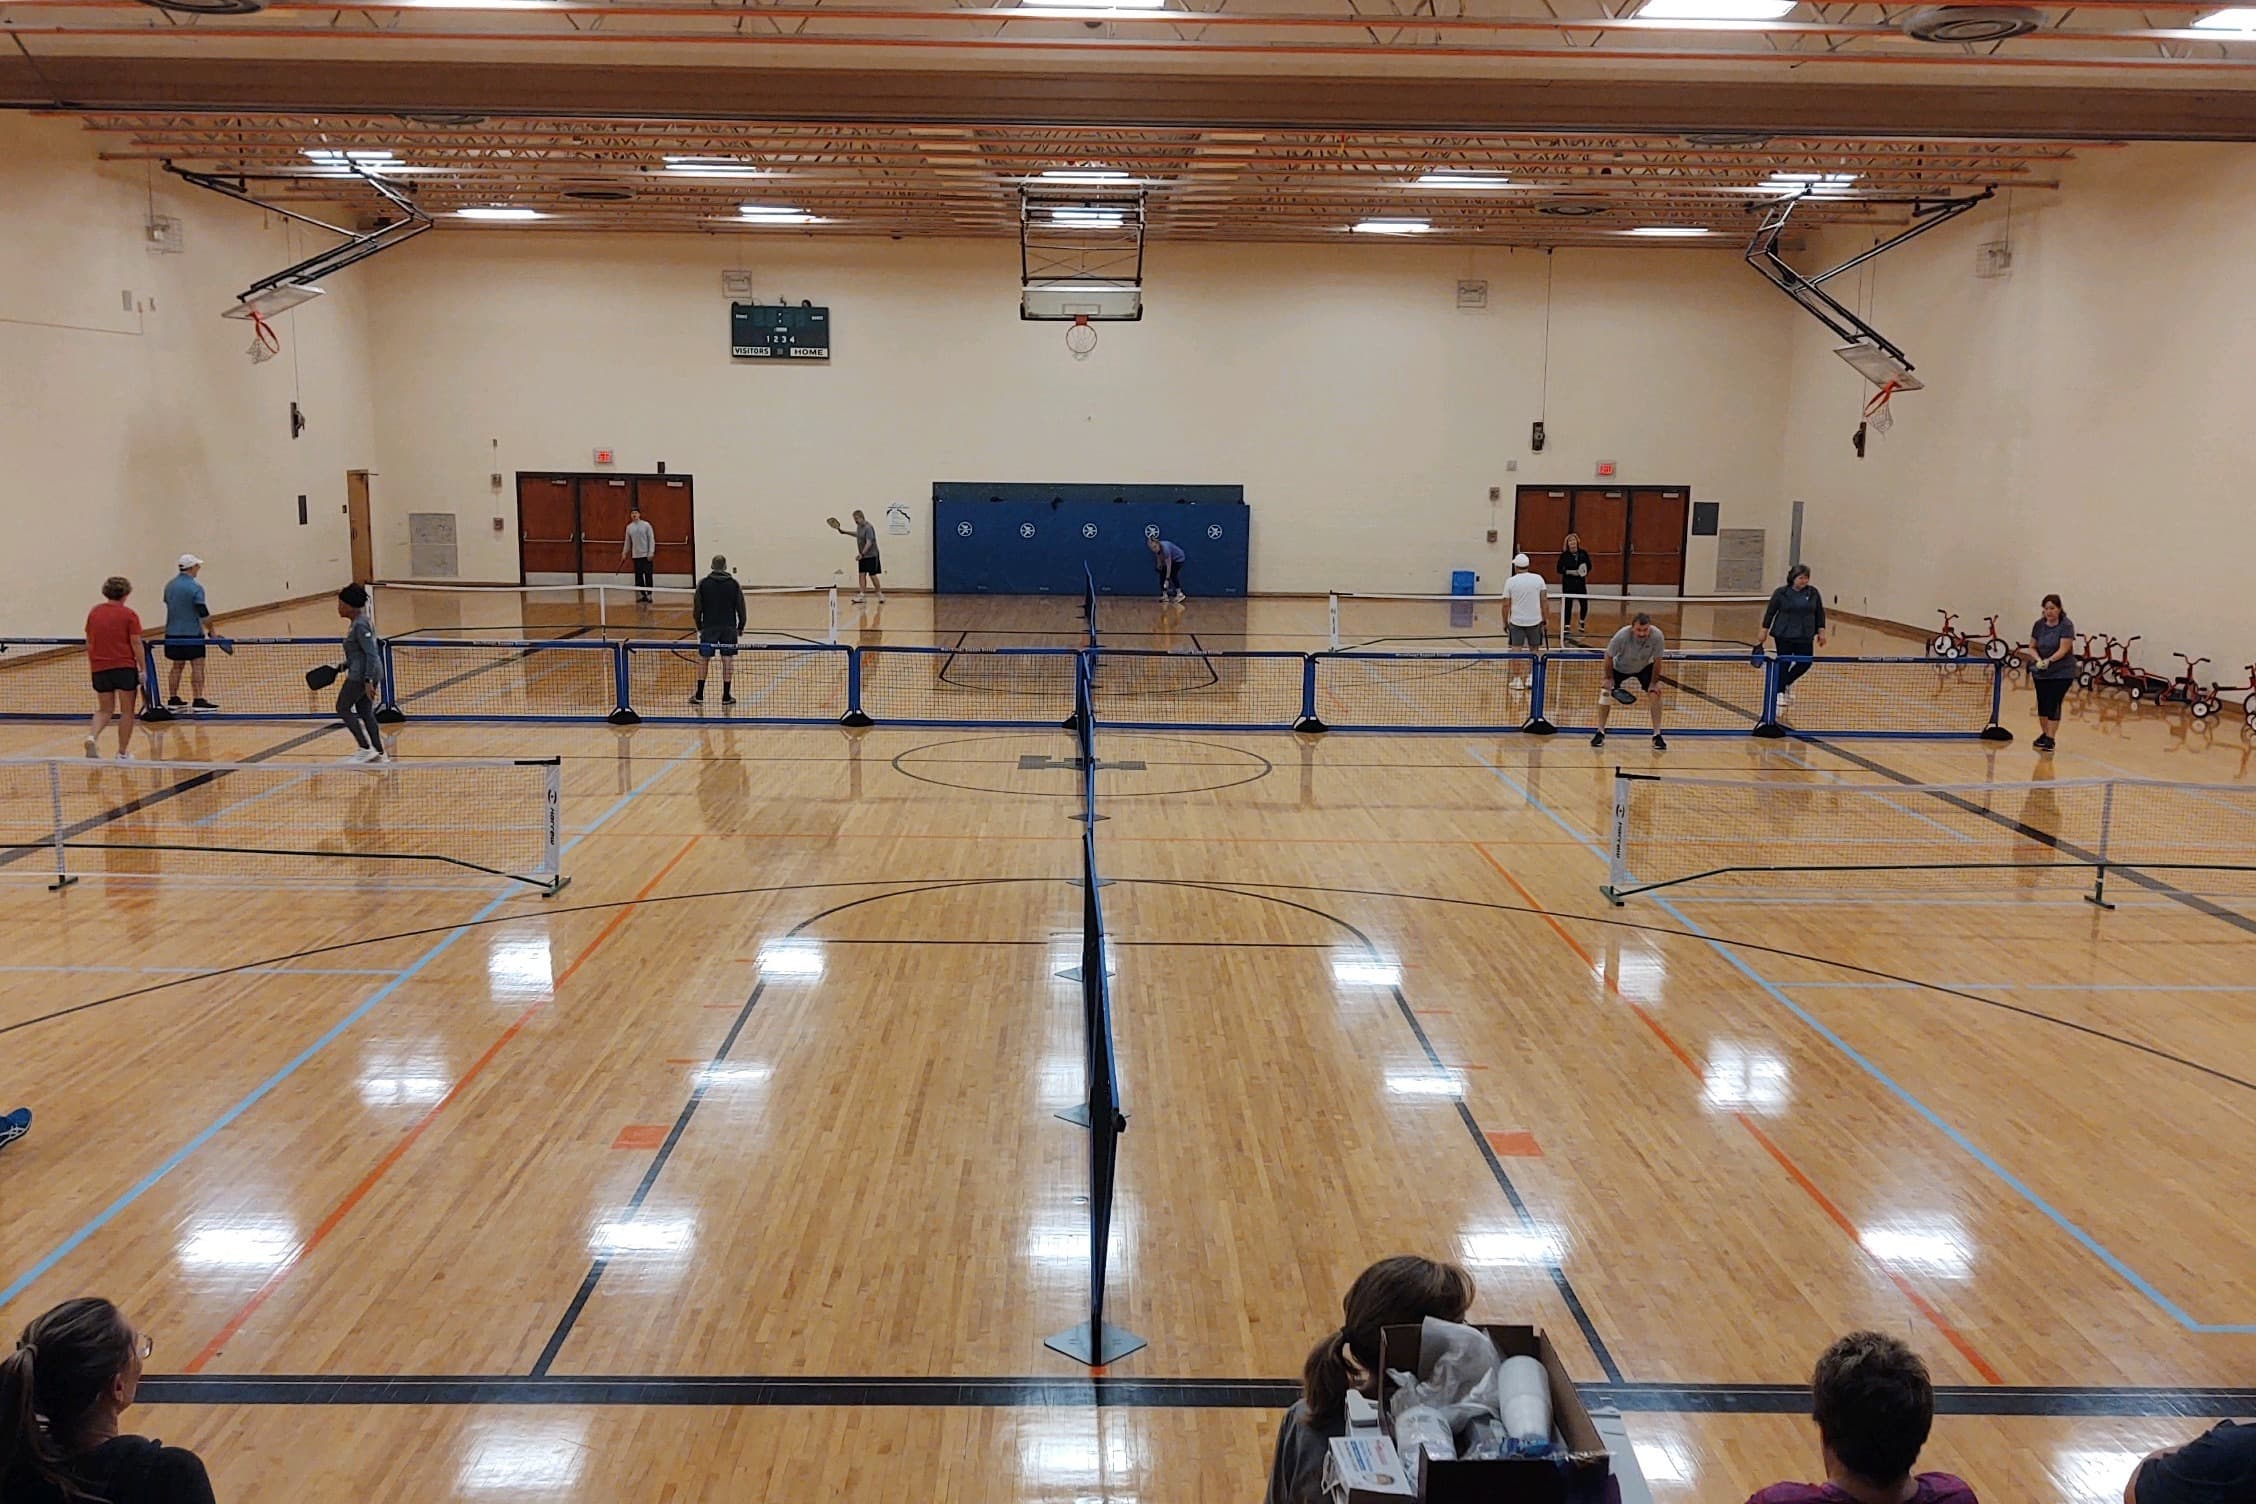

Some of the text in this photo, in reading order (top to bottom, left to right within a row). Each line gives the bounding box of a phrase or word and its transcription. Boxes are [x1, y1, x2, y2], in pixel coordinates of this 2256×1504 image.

[773, 335, 779, 343] 2
[781, 335, 787, 343] 3
[789, 335, 796, 343] 4
[735, 347, 769, 355] VISITORS
[794, 348, 824, 356] HOME
